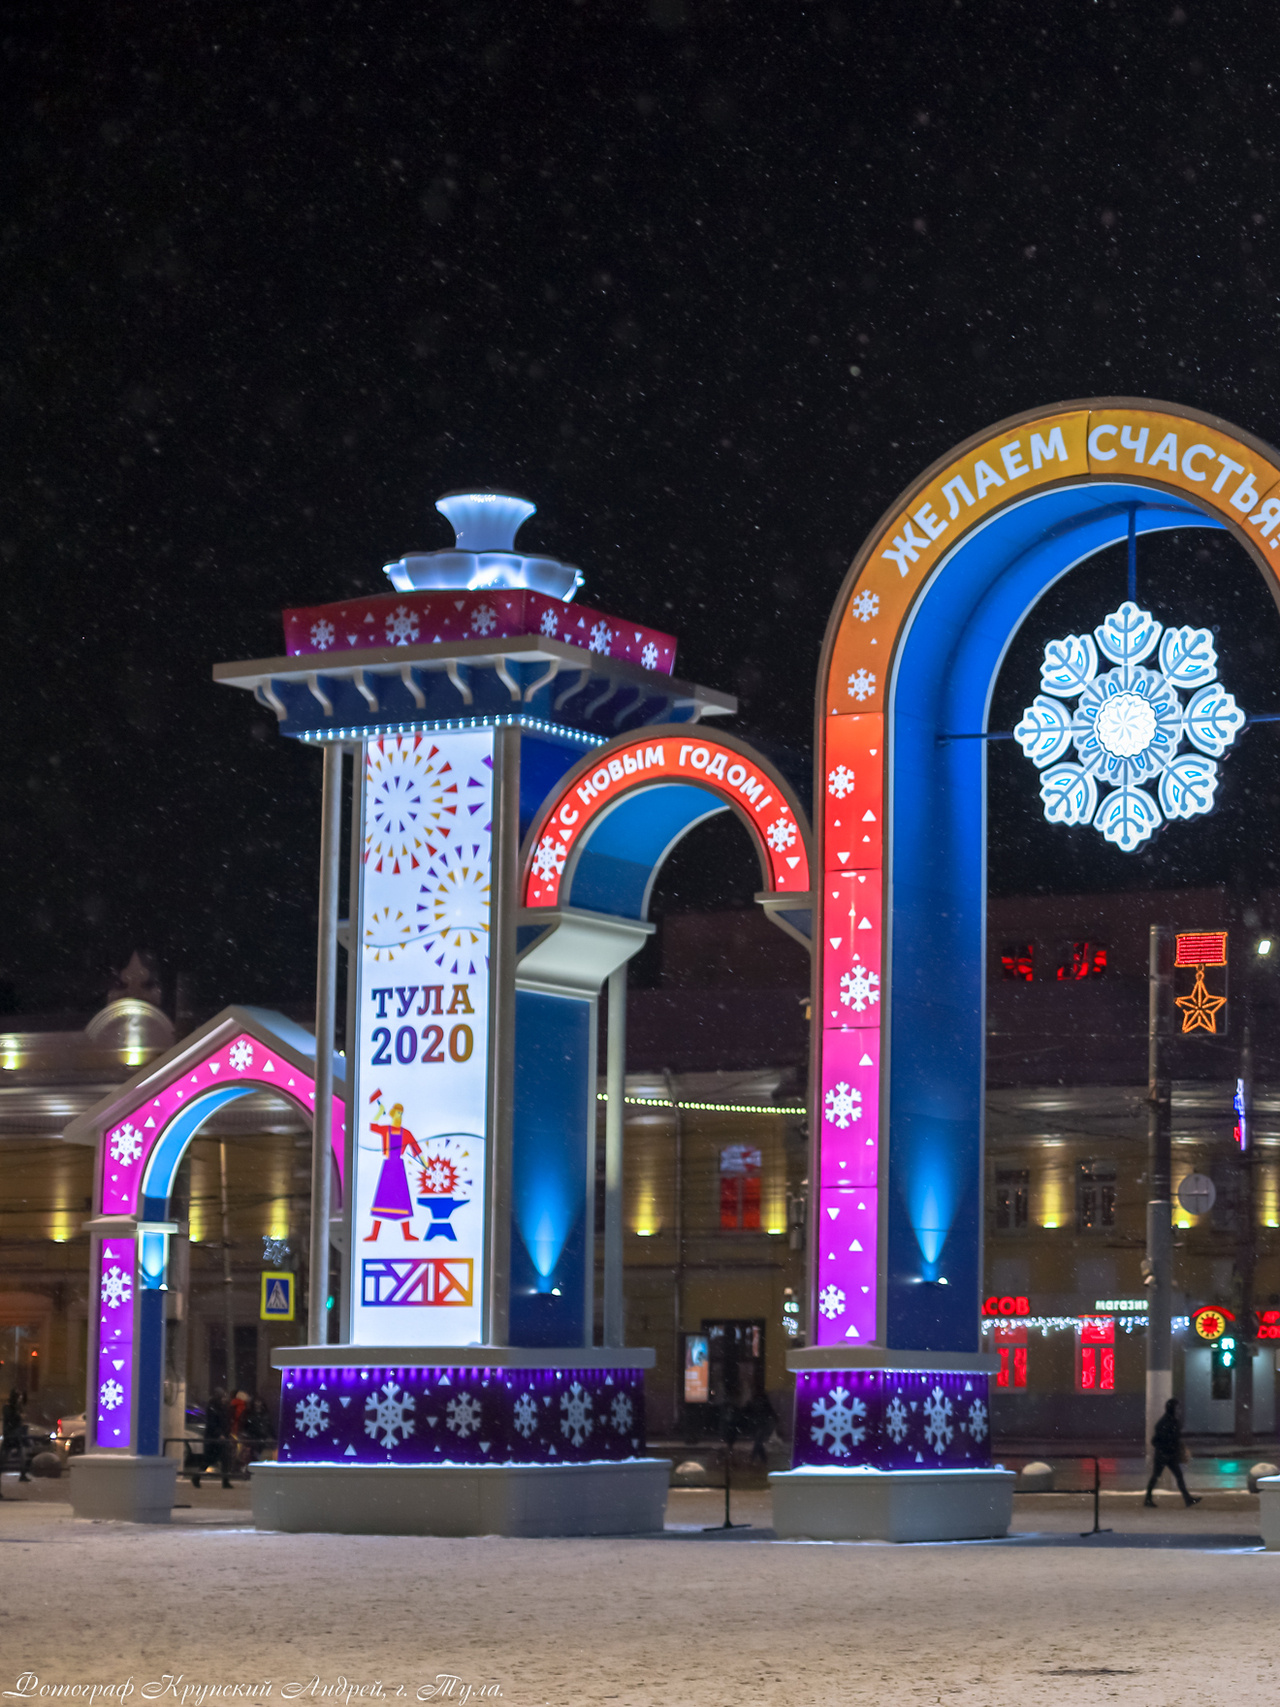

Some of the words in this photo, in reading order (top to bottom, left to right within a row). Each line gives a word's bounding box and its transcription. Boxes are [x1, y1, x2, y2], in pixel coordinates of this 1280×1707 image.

[881, 427, 1068, 578] ЖЕЛАЕМ
[559, 803, 579, 825] С
[577, 745, 665, 805] НОВЫМ
[678, 745, 773, 812] ГОДОМ!
[371, 983, 475, 1018] ТУЛА
[371, 1023, 474, 1066] 2020
[981, 1296, 1030, 1316] СОВ
